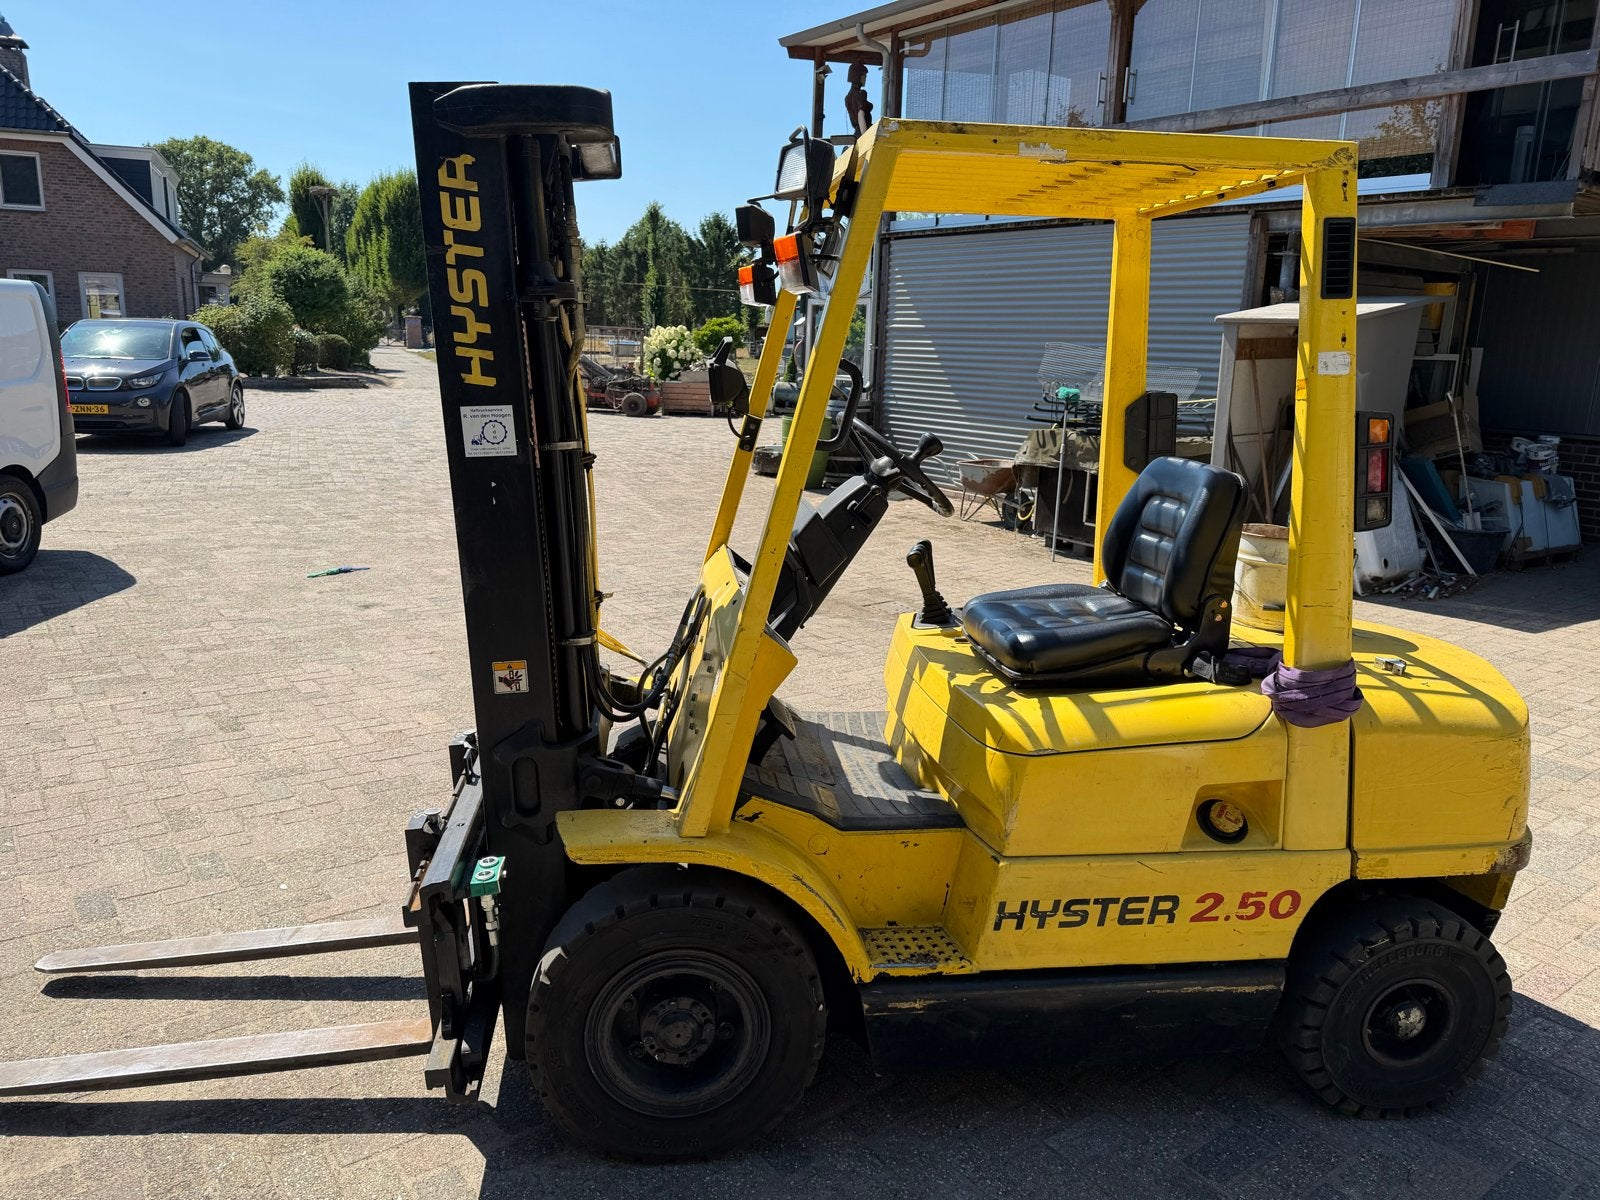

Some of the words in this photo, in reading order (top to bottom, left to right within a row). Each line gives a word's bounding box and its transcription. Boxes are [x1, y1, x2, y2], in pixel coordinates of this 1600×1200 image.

[438, 154, 496, 387] HYSTER
[993, 894, 1180, 931] HYSTER
[1189, 889, 1302, 922] 2.50
